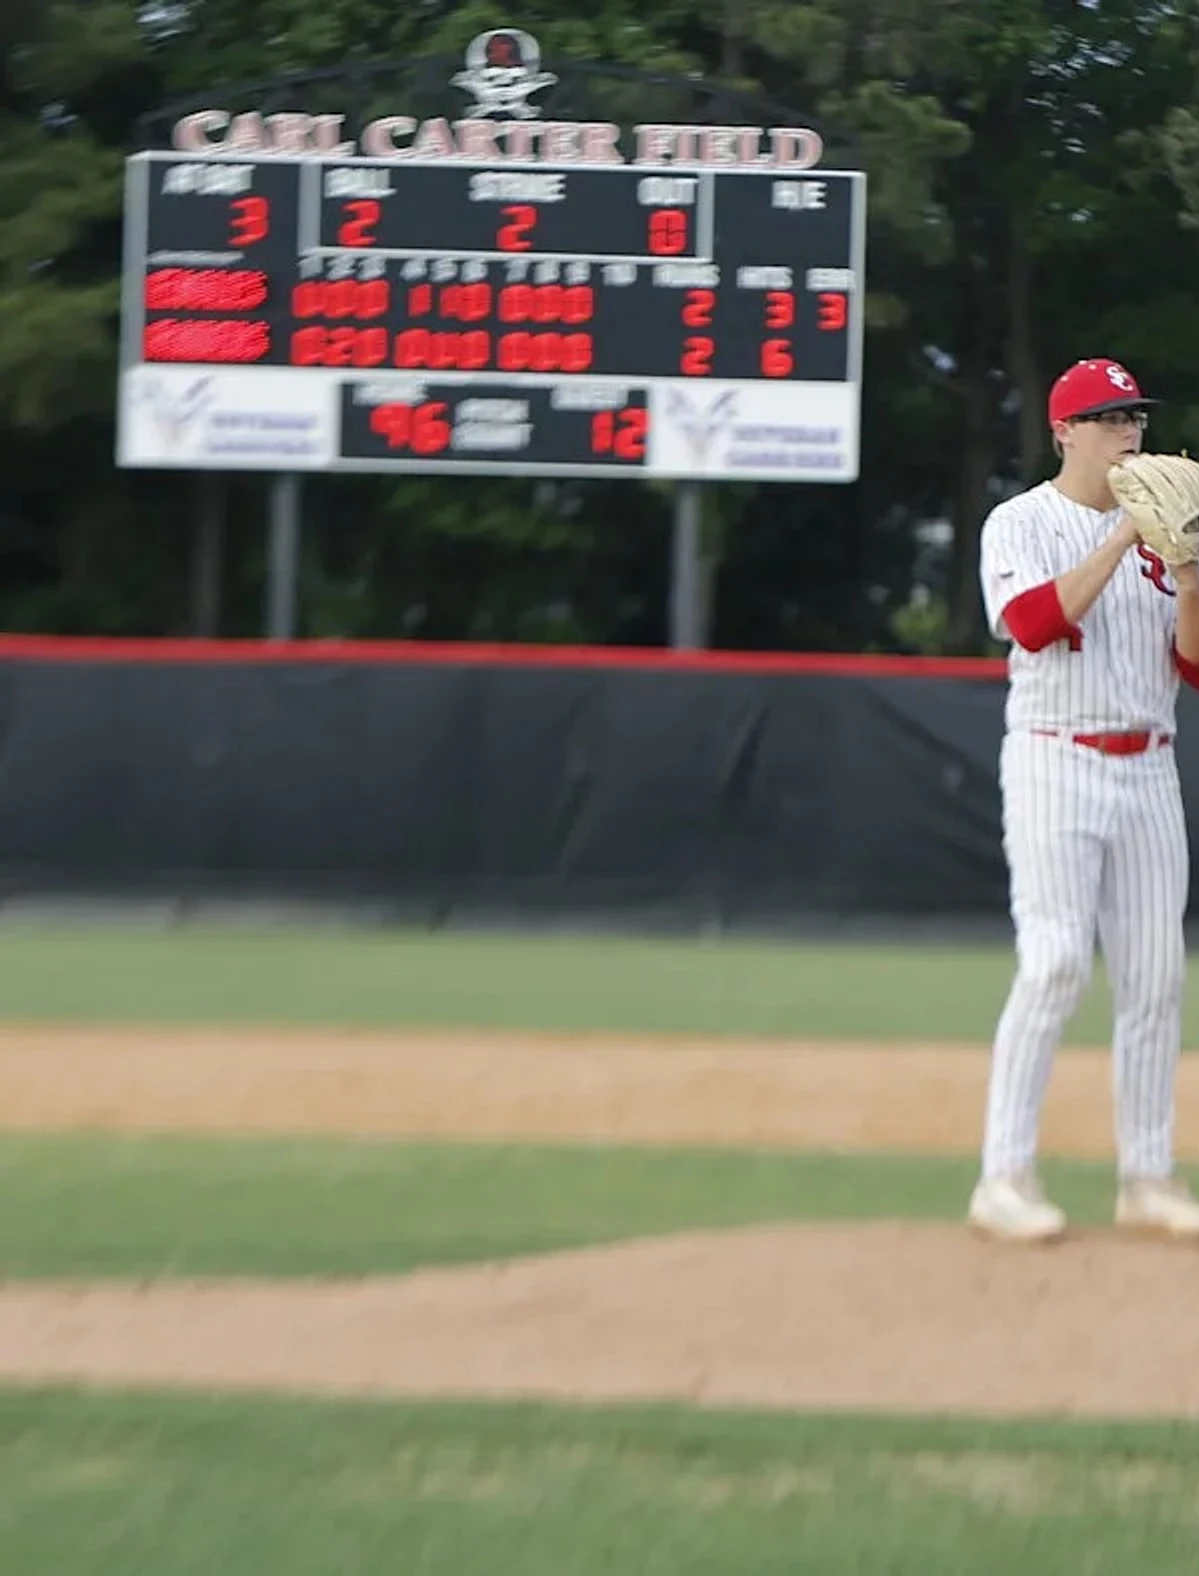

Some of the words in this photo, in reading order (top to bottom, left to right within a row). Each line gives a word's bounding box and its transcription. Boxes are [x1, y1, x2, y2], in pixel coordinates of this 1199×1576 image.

[172, 109, 356, 157] CARL
[361, 116, 624, 164] CARTER
[632, 124, 823, 169] FIELD
[227, 196, 270, 247] 3
[338, 200, 381, 248] 2
[497, 205, 538, 252] 2
[648, 209, 688, 255] 0
[681, 289, 715, 328] 2
[764, 292, 795, 330] 3
[816, 293, 848, 331] 3
[680, 337, 715, 377] 2
[760, 338, 794, 378] 6
[369, 401, 452, 454] 96
[591, 406, 648, 459] 12
